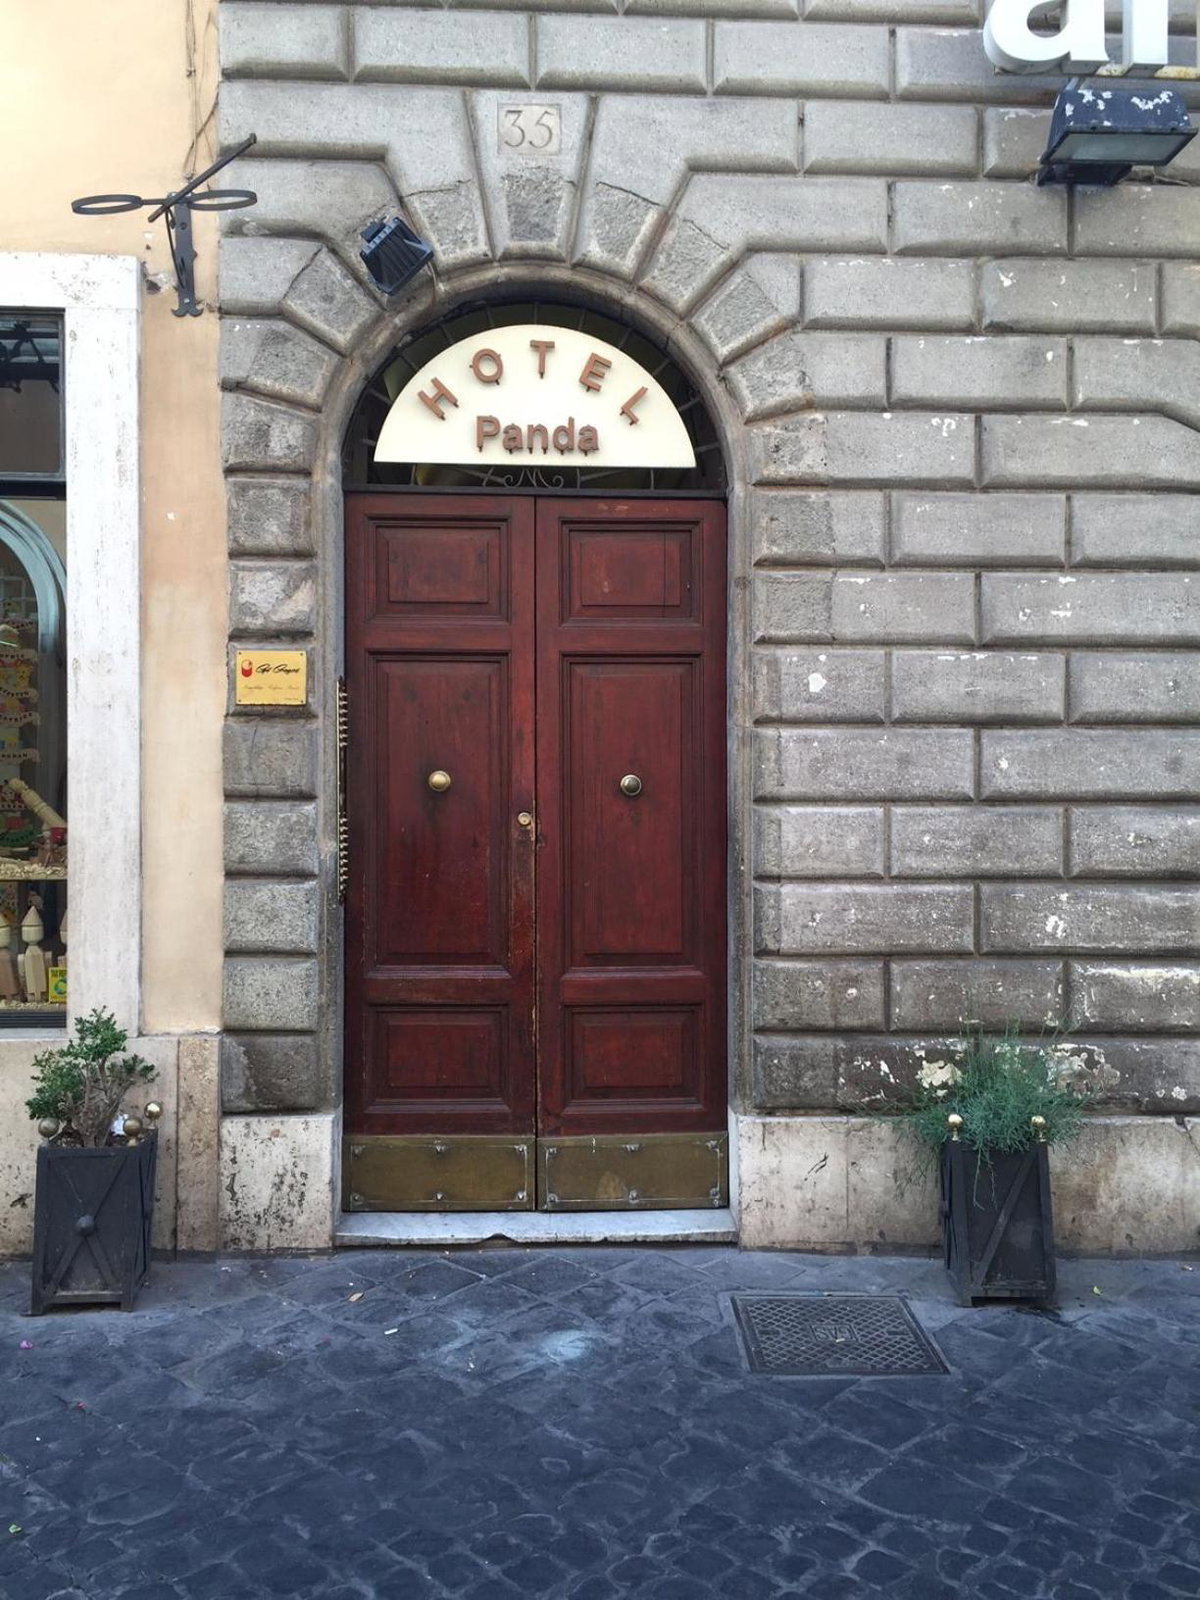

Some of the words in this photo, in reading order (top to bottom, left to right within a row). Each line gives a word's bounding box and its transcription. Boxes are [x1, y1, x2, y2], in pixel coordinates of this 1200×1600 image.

[504, 110, 554, 148] 35
[417, 340, 648, 426] HOTEL
[476, 415, 599, 456] Panda
